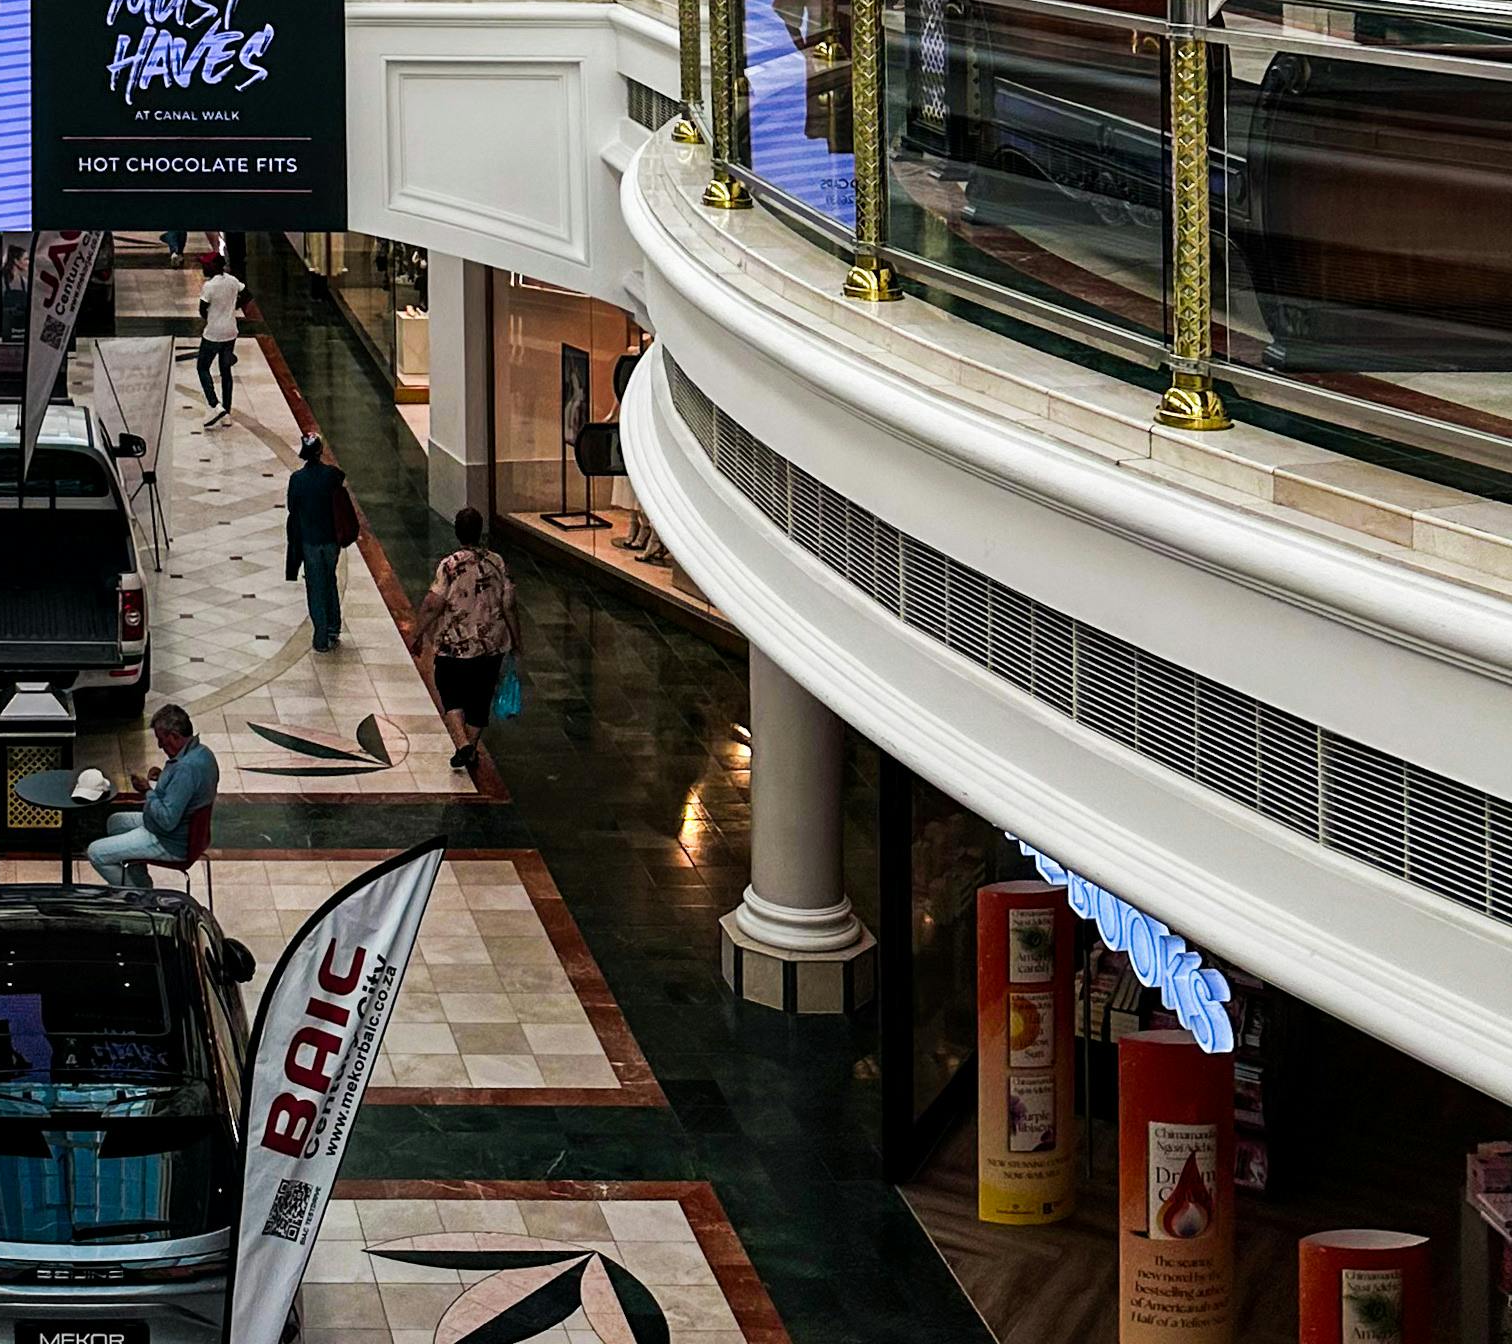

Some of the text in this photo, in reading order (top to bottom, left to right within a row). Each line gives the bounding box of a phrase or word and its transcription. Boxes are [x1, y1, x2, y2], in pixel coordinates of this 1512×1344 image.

[106, 23, 275, 106] HAVES
[134, 111, 240, 121] AT CANAL WALK
[78, 156, 298, 174] HOT CHOCOLATE FITS
[55, 251, 85, 315] Century
[260, 937, 367, 1159] BAIC
[326, 965, 397, 1157] www.mekorbaic.co.za
[1156, 1166, 1216, 1185] Drm
